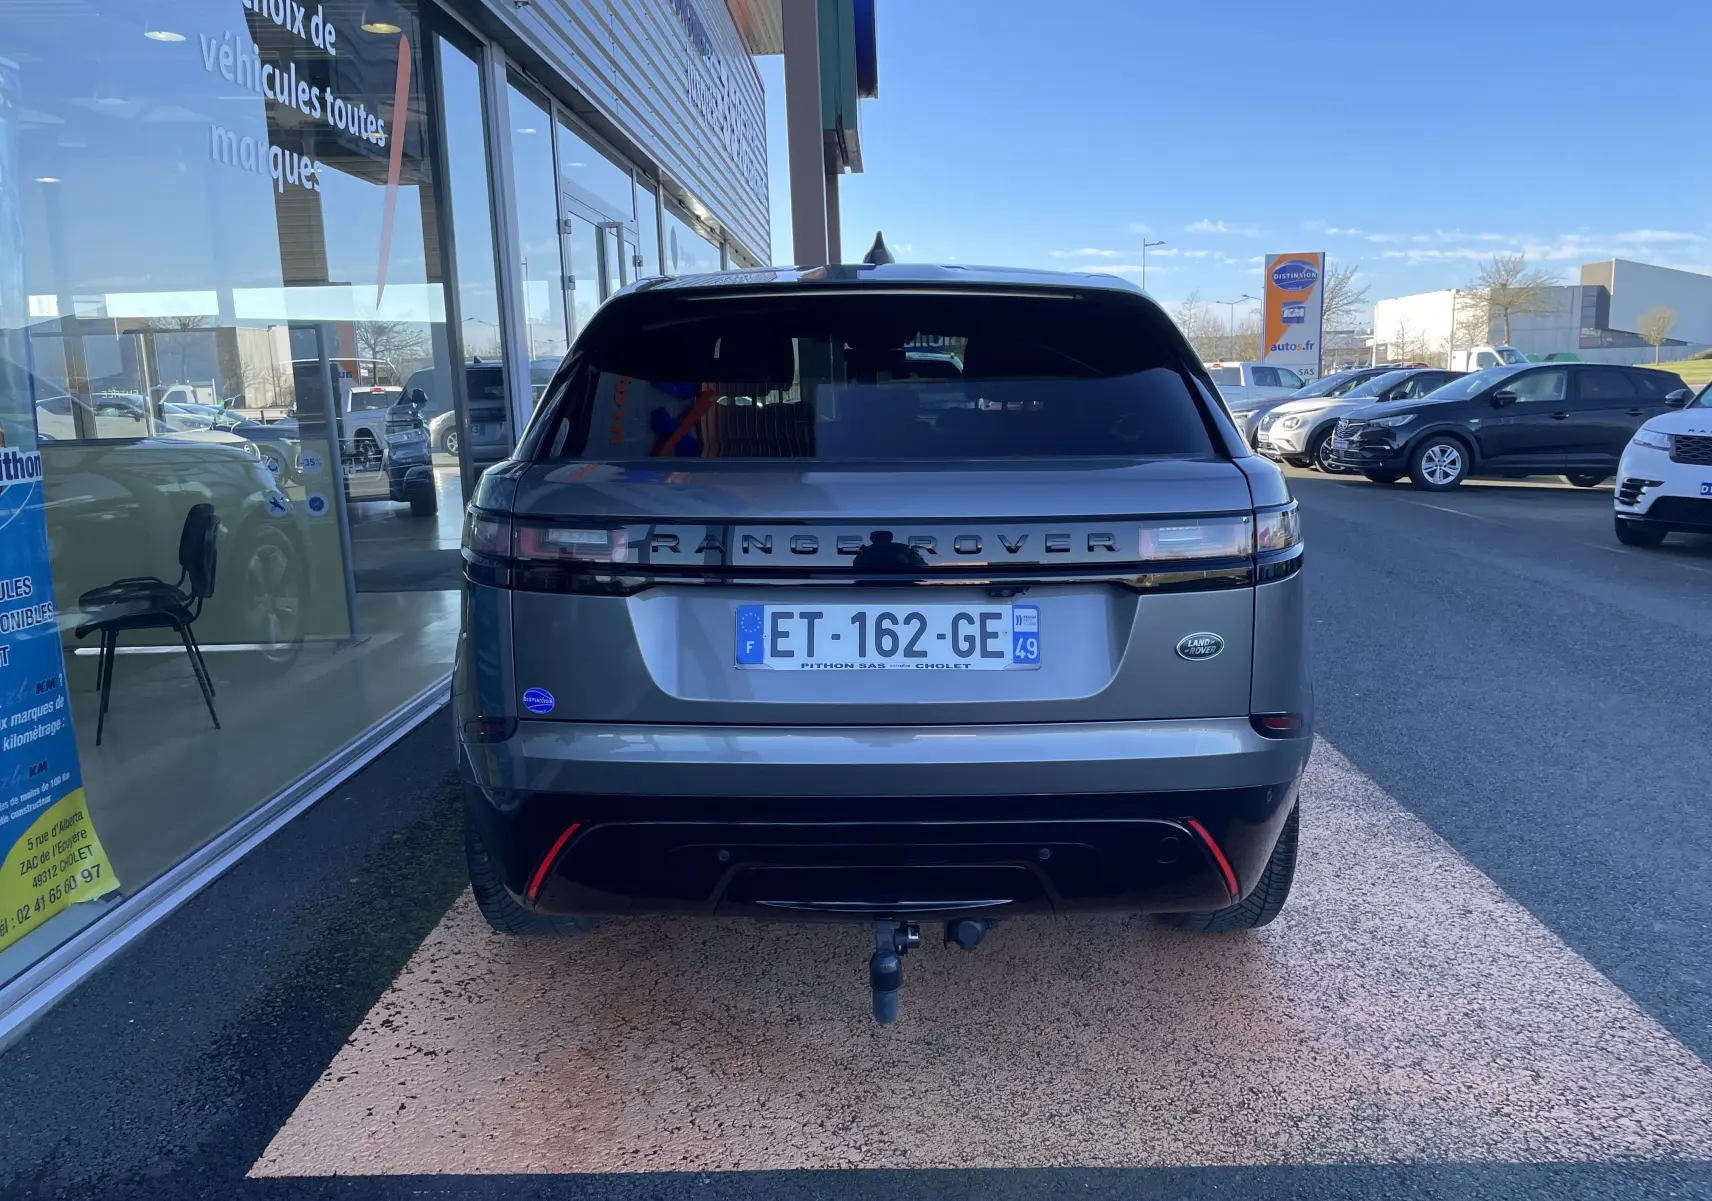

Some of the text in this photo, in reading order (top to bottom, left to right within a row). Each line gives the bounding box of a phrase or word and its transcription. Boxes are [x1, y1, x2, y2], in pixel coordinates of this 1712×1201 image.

[241, 0, 336, 56] oix de
[199, 30, 386, 148] véhicules toutes
[211, 125, 322, 194] marques
[1273, 272, 1317, 280] DISTINXION
[1270, 340, 1315, 352] autos.fr
[1299, 368, 1315, 376] SAS
[651, 532, 1120, 555] RANGE ROVER
[770, 611, 1005, 658] ET-162-GE
[1187, 638, 1210, 648] LAND
[746, 640, 755, 654] F
[1015, 638, 1038, 659] 49
[1189, 645, 1217, 655] ROVER
[36, 676, 56, 695] KM
[11, 701, 54, 728] marques
[55, 695, 65, 710] de
[27, 811, 84, 851] 5 rue d'Alberta
[20, 856, 38, 875] ZAC
[40, 851, 50, 864] de
[33, 844, 94, 888] 49312 CHOLET
[16, 904, 31, 924] 02
[35, 895, 46, 912] 41
[49, 884, 62, 904] 65
[64, 875, 77, 894] 60
[81, 864, 101, 883] 97
